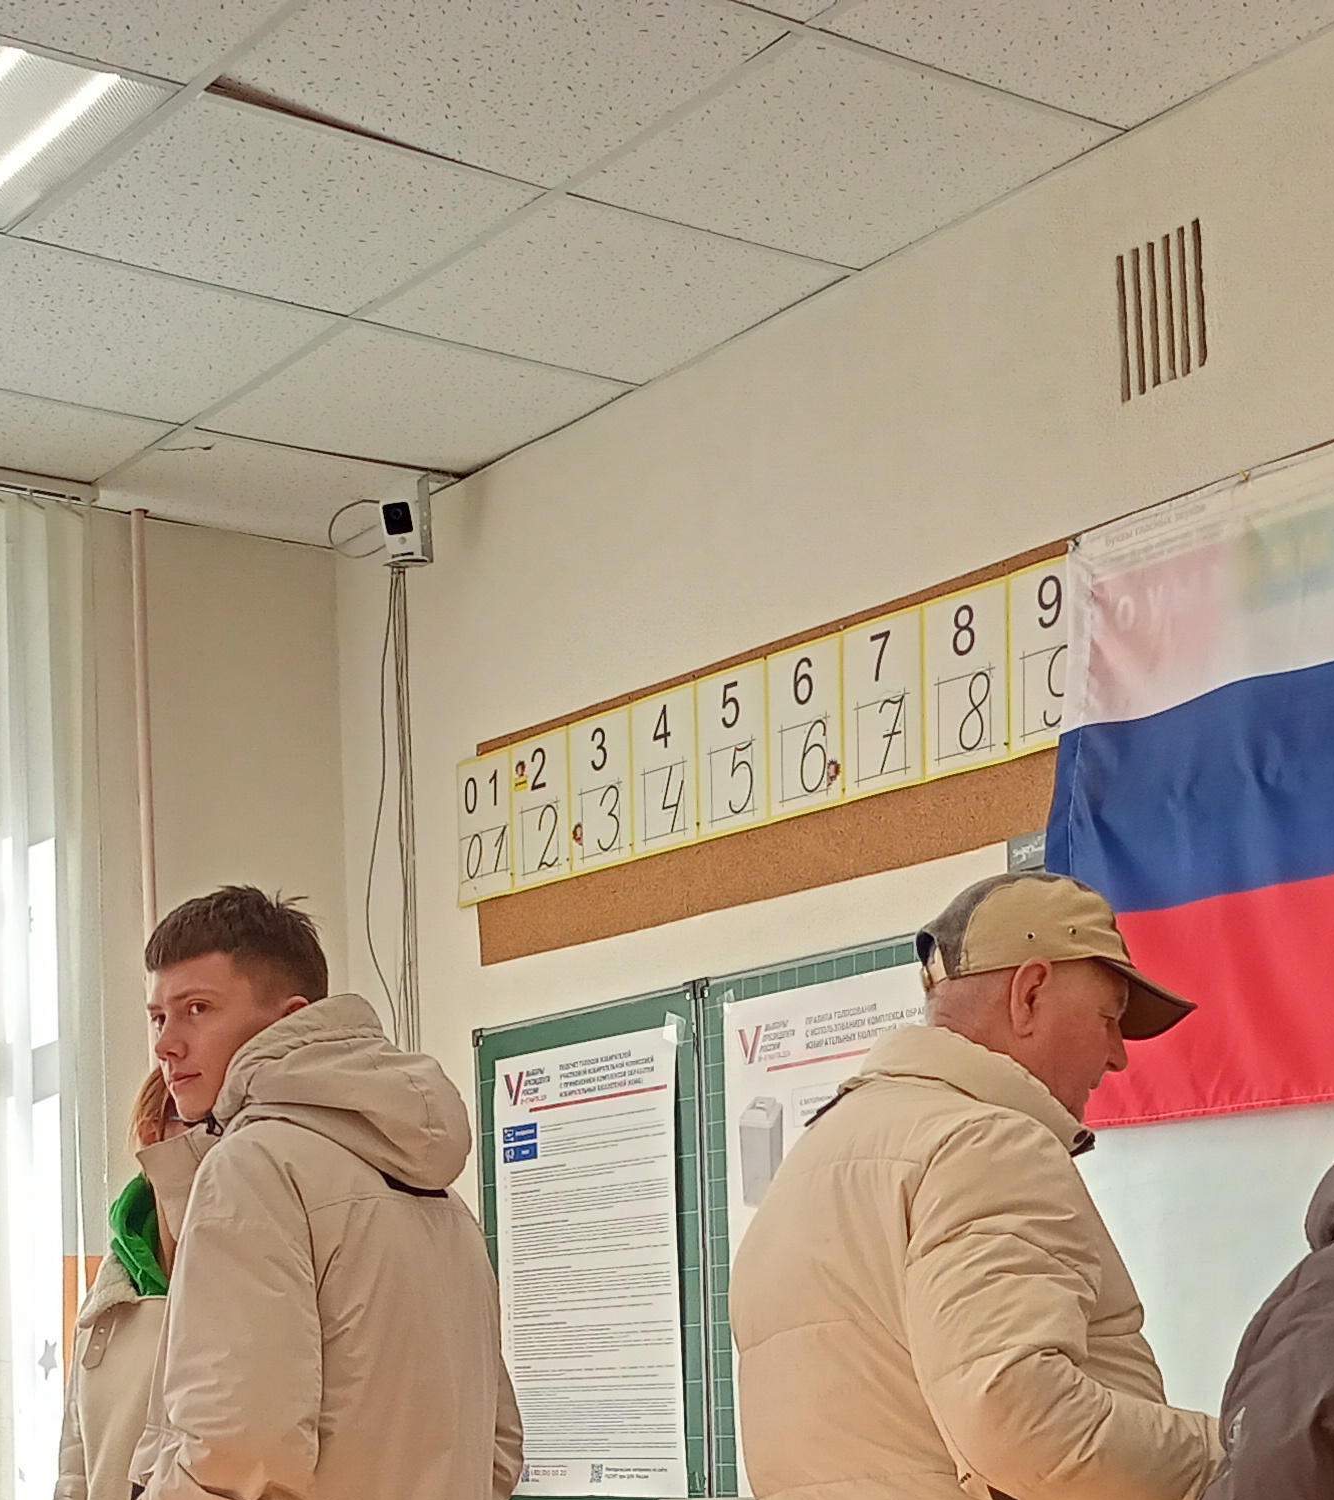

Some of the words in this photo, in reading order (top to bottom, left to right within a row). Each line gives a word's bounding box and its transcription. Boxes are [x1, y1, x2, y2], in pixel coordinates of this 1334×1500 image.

[464, 776, 478, 815] 0
[488, 768, 498, 807] 1
[530, 747, 547, 792] 2
[589, 727, 609, 772] 3
[651, 704, 673, 750] 4
[720, 681, 741, 729] 5
[792, 656, 814, 706] 6
[869, 630, 892, 683] 7
[951, 604, 976, 657] 8
[1037, 574, 1063, 630] 9
[537, 803, 559, 871] 2
[598, 784, 620, 854] 3
[660, 765, 685, 835] 4
[728, 741, 754, 815] 5
[799, 718, 827, 794] 6
[877, 694, 907, 775] 7
[957, 670, 991, 753] 8
